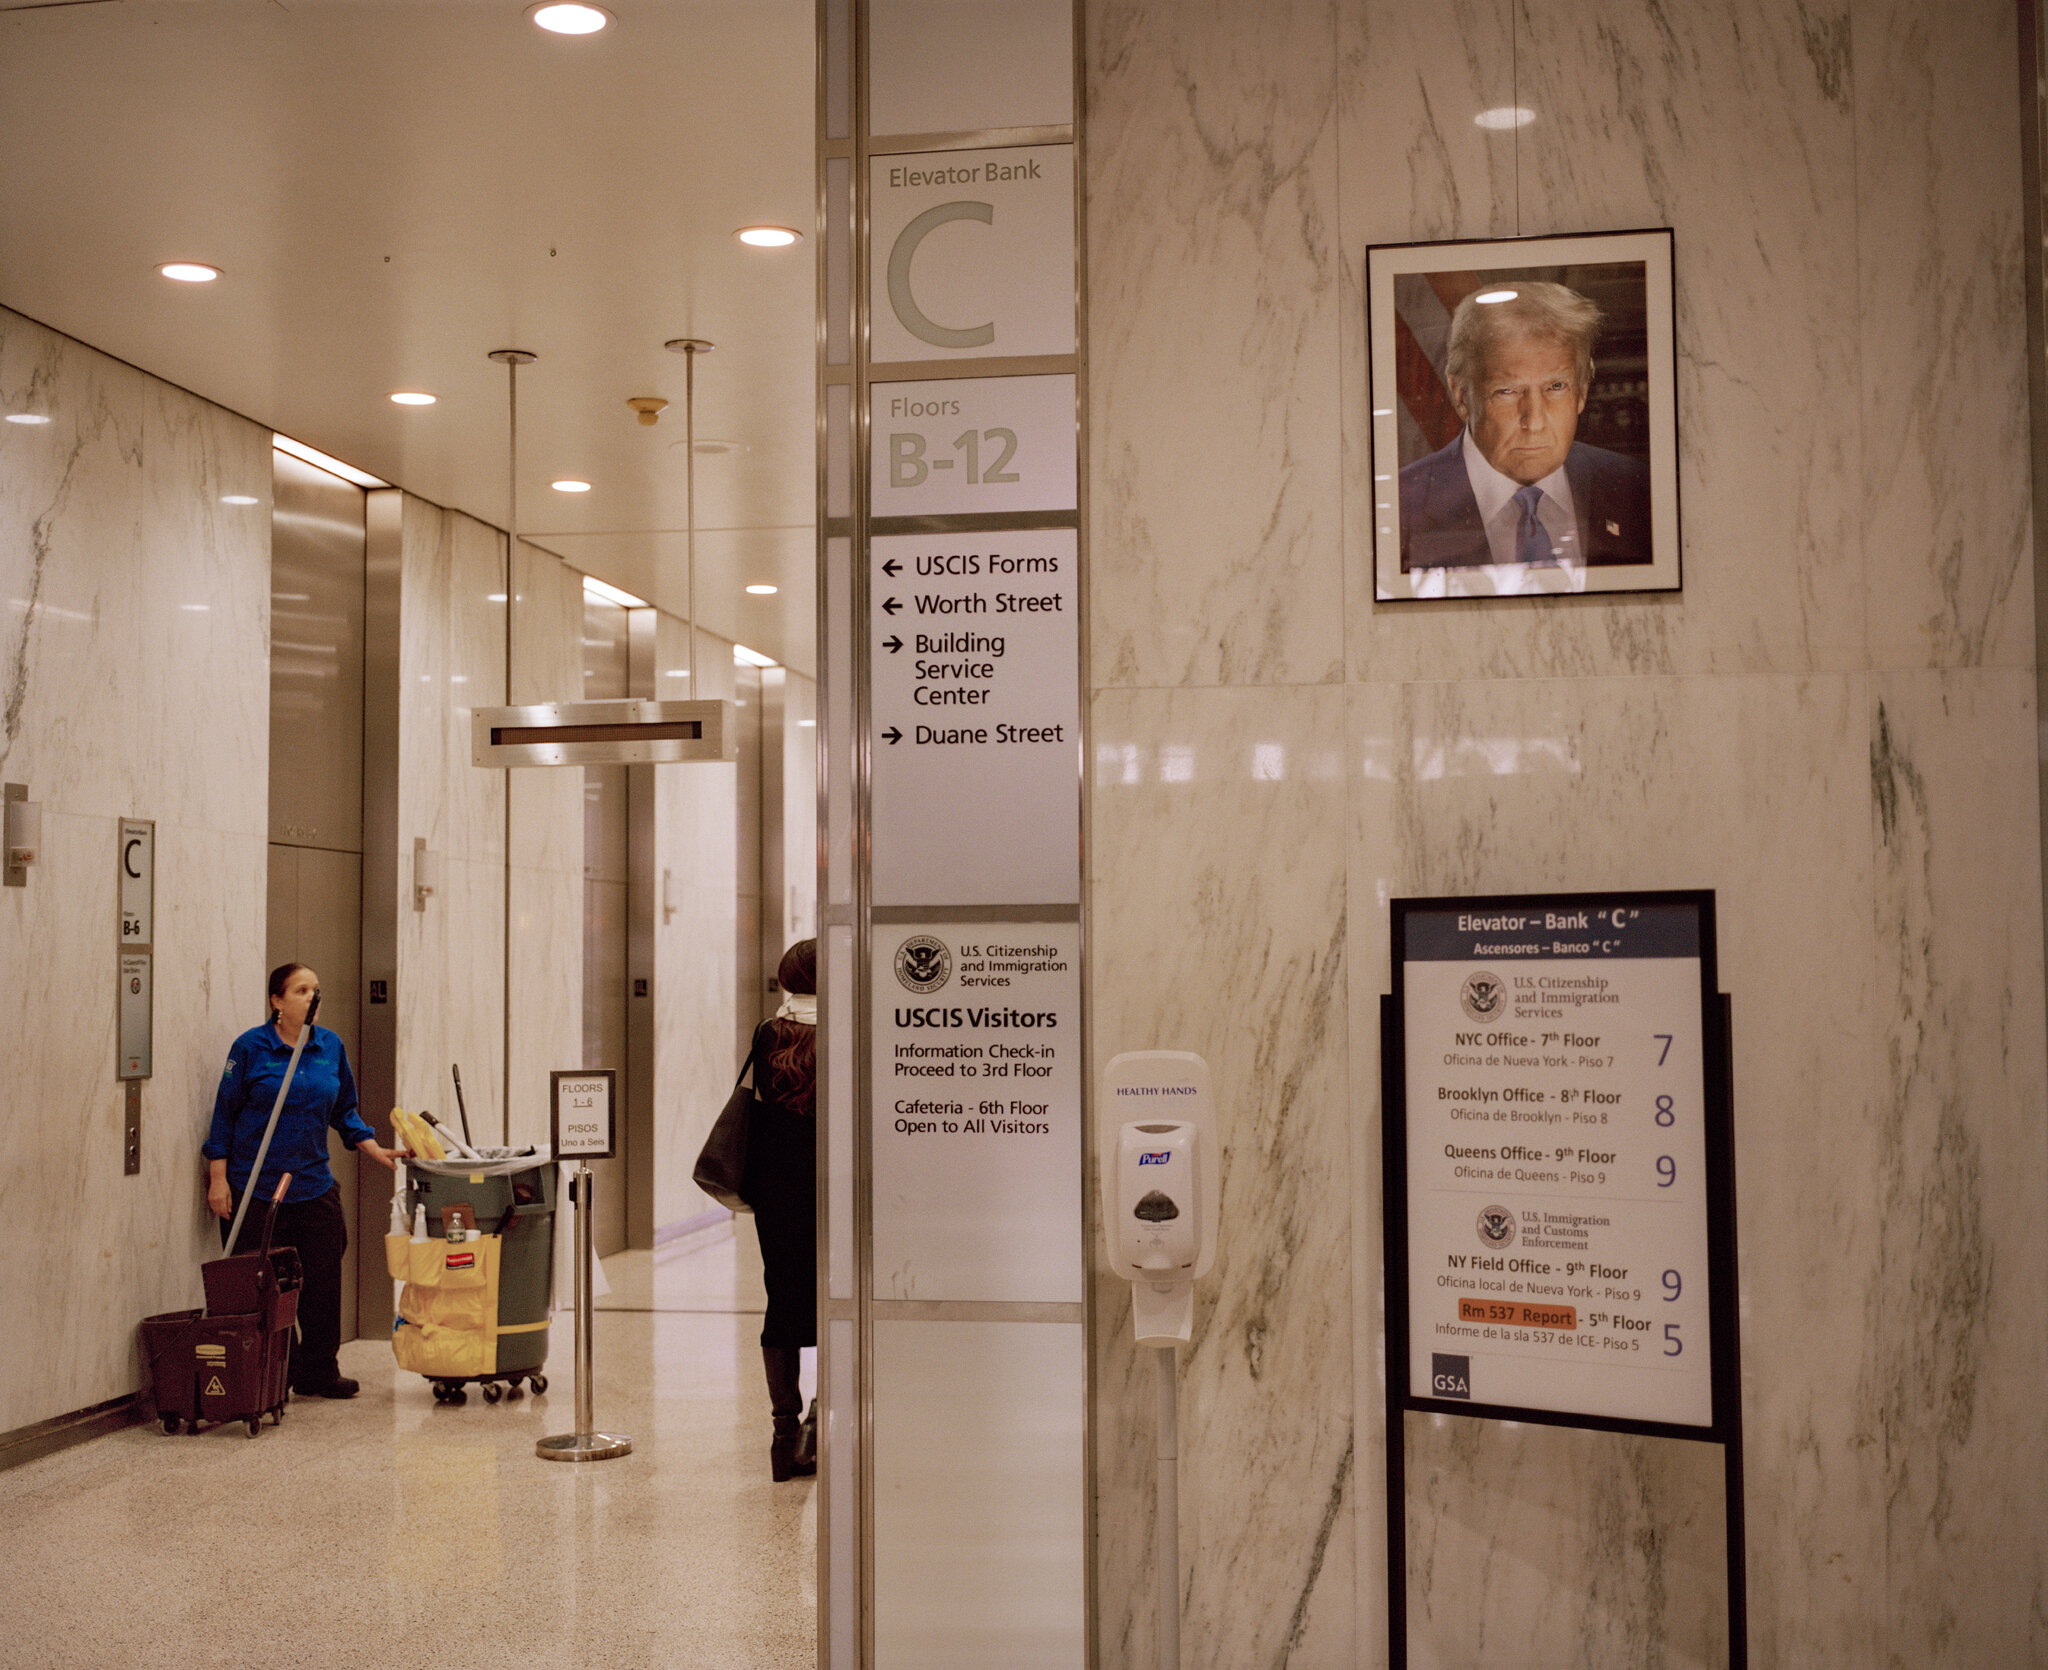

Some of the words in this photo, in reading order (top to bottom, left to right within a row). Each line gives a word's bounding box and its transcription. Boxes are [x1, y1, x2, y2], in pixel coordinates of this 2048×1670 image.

[890, 167, 980, 187] Elevator
[986, 159, 1041, 181] Bank
[887, 200, 994, 348] C
[892, 397, 959, 417] Floors
[890, 428, 1019, 488] B-12
[917, 555, 979, 575] USCIS
[990, 555, 1058, 573] Forms
[915, 593, 986, 614] Worth
[996, 593, 1062, 612] Street
[916, 632, 1004, 657] Building
[916, 659, 993, 679] Service
[914, 686, 990, 705] Center
[916, 726, 987, 744] Duane
[996, 724, 1063, 743] Street
[124, 839, 141, 878] C
[124, 920, 140, 935] B-6
[1459, 915, 1526, 931] Elevator
[1546, 912, 1588, 929] Bank
[961, 946, 981, 956] U.S.
[987, 945, 1057, 959] Citizenship
[1474, 943, 1539, 954] Ascensores
[1553, 942, 1589, 953] Banco
[961, 960, 984, 971] and
[989, 960, 1067, 974] Immigration
[961, 975, 1010, 986] Services
[1514, 977, 1535, 988] U.S.
[1539, 976, 1608, 992] Citizenship
[1515, 991, 1536, 1003] and
[1542, 990, 1619, 1007] Immigration
[895, 1008, 963, 1027] USCIS
[967, 1007, 1057, 1027] Visitors
[1515, 1007, 1563, 1018] Services
[896, 1043, 983, 1058] Information
[989, 1044, 1054, 1058] Check-in
[1456, 1033, 1482, 1045] NYC
[1487, 1033, 1527, 1046] Office
[1564, 1033, 1600, 1047] Floor
[1654, 1035, 1672, 1066] 7
[1444, 1054, 1482, 1065] Oficina
[1486, 1055, 1499, 1066] de
[1504, 1055, 1539, 1066] Nueva
[1543, 1056, 1567, 1067] York
[1579, 1056, 1603, 1067] Piso
[1608, 1056, 1613, 1067] 7
[895, 1063, 954, 1076] Proceed
[960, 1064, 976, 1076] to
[983, 1063, 1007, 1076] 3rd
[1015, 1063, 1052, 1077] Floor
[563, 1084, 603, 1093] FLOORS
[895, 1100, 962, 1114] Cafeteria
[979, 1101, 1003, 1114] 6th
[1011, 1101, 1048, 1114] Floor
[1439, 1087, 1498, 1103] Brooklyn
[1503, 1088, 1544, 1102] Office
[1584, 1090, 1621, 1104] Floor
[1655, 1095, 1675, 1127] 8
[1451, 1108, 1489, 1120] Oficina
[1493, 1110, 1507, 1121] de
[1511, 1111, 1561, 1124] Brooklyn
[1573, 1112, 1597, 1124] Piso
[1601, 1113, 1607, 1124] 8
[568, 1124, 598, 1133] PISOS
[895, 1119, 936, 1135] Open
[942, 1121, 958, 1133] to
[964, 1119, 984, 1133] All
[991, 1120, 1049, 1133] Visitors
[561, 1139, 577, 1147] Uno
[1445, 1145, 1496, 1159] Queens
[1501, 1146, 1542, 1160] Office
[1579, 1149, 1616, 1163] Floor
[1656, 1156, 1676, 1187] 9
[1455, 1166, 1493, 1178] Oficina
[1497, 1168, 1511, 1179] de
[1515, 1169, 1559, 1181] Queens
[1571, 1171, 1594, 1183] Piso
[1598, 1172, 1605, 1184] 9
[1522, 1211, 1540, 1222] U.S.
[1544, 1213, 1610, 1228] Immigration
[1522, 1224, 1540, 1234] and
[1544, 1224, 1588, 1237] Customs
[1522, 1236, 1588, 1250] Enforcement
[1449, 1255, 1466, 1268] NY
[1472, 1257, 1503, 1271] Field
[1509, 1259, 1550, 1274] Office
[1590, 1264, 1628, 1279] Floor
[1662, 1269, 1681, 1301] 9
[1437, 1275, 1475, 1288] Oficina
[1479, 1278, 1505, 1291] local
[1509, 1281, 1523, 1292] de
[1527, 1282, 1563, 1295] Nueva
[1568, 1286, 1592, 1297] York
[1605, 1288, 1629, 1300] Piso
[1633, 1290, 1641, 1301] 9
[1436, 1322, 1481, 1337] Informe
[1483, 1327, 1497, 1338] de
[1501, 1328, 1510, 1339] la
[1514, 1330, 1529, 1341] sla
[1534, 1329, 1556, 1343] 537
[1559, 1334, 1573, 1345] de
[1604, 1337, 1628, 1350] Piso
[1632, 1339, 1639, 1351] 5
[1463, 1304, 1484, 1317] Rm
[1490, 1306, 1514, 1319] 537
[1523, 1309, 1572, 1325] Report
[1614, 1315, 1651, 1331] Floor
[1664, 1324, 1682, 1356] 5
[1434, 1374, 1468, 1392] GSA
